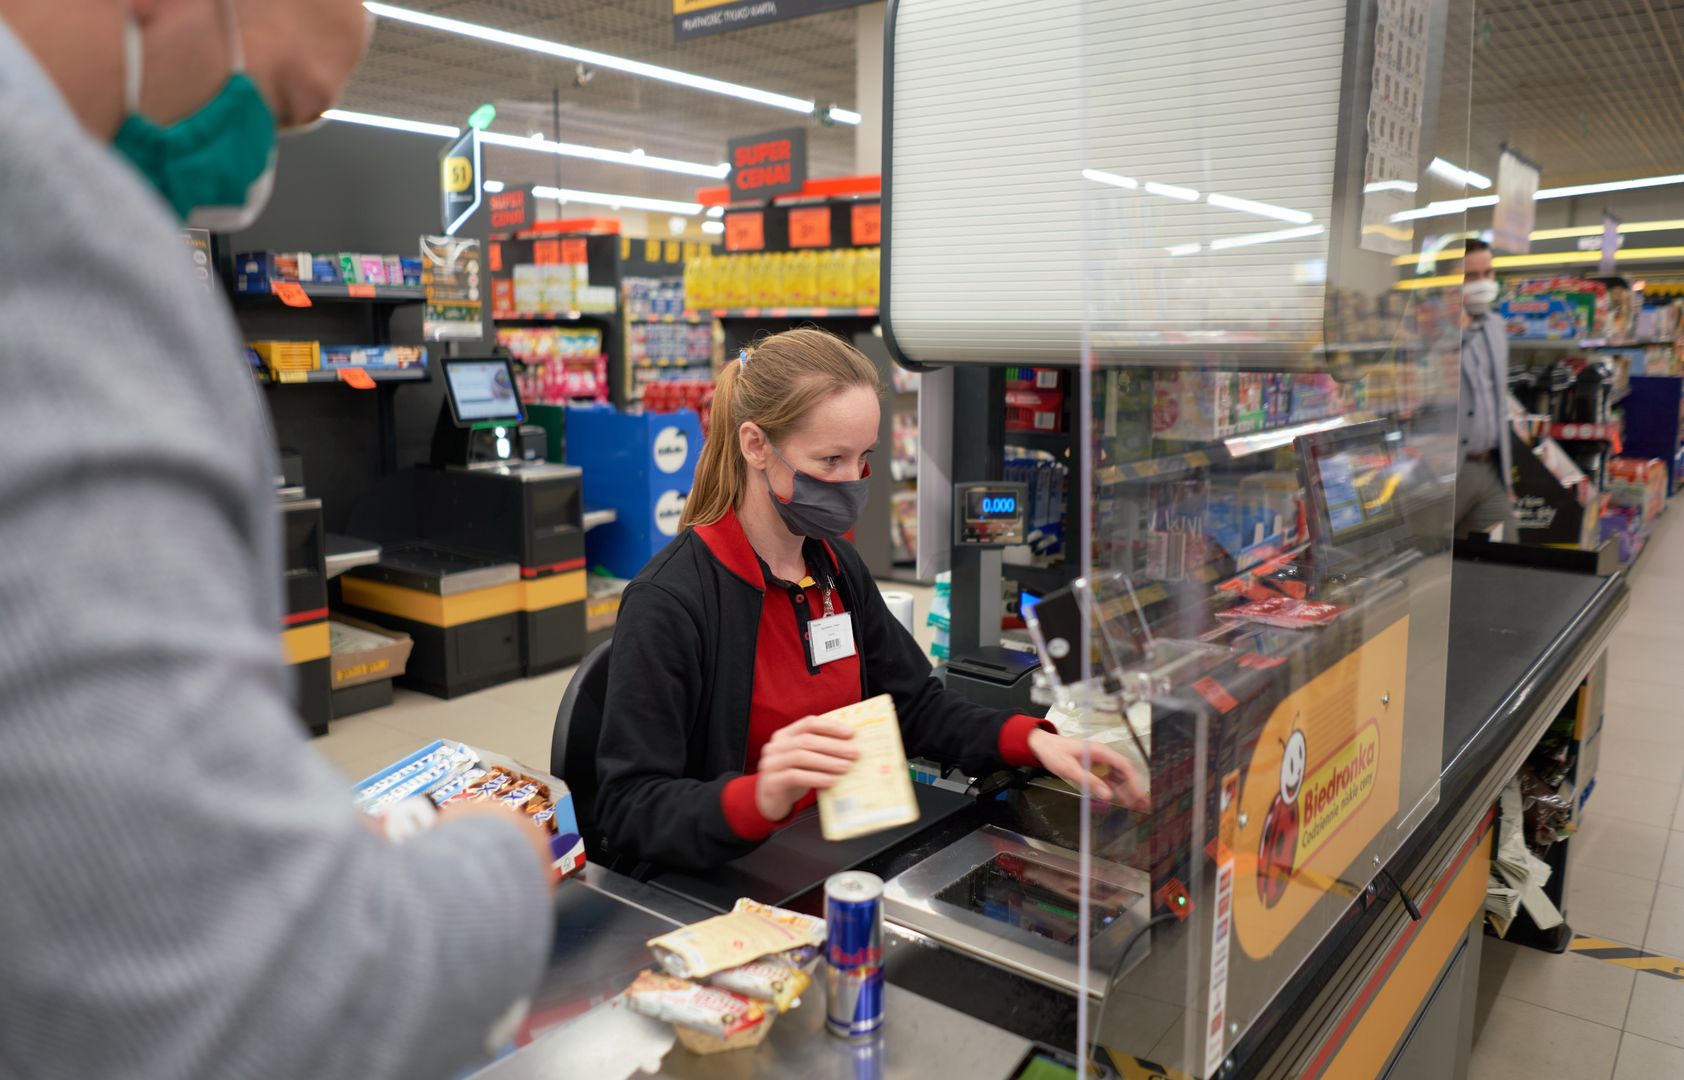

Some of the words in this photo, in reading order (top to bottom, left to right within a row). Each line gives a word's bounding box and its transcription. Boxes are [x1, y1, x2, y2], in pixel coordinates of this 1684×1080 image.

[735, 139, 791, 168] SUPER
[735, 162, 791, 190] CENA!
[982, 496, 1015, 513] 0.000
[1303, 741, 1376, 828] Biedronka
[1302, 803, 1340, 849] Codziennie
